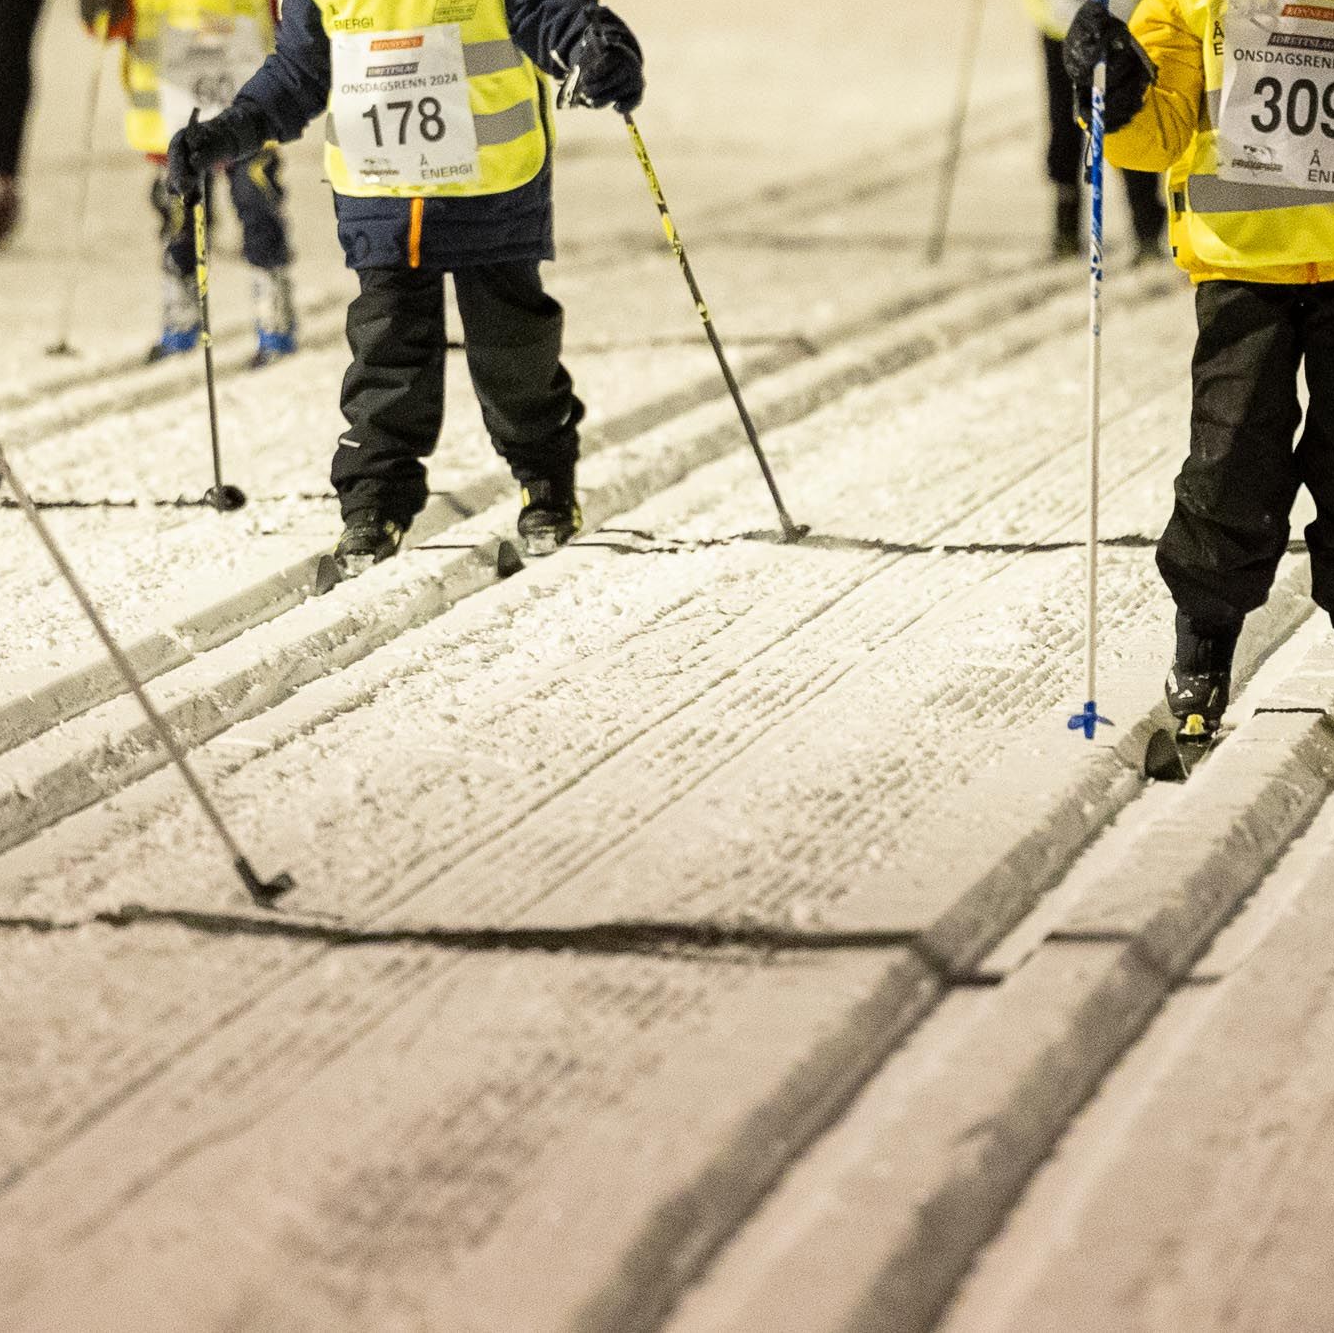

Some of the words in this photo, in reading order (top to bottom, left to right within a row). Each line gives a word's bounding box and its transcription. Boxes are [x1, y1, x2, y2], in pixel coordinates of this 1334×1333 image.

[341, 77, 427, 94] ONSDAGSRENN
[430, 73, 458, 87] 2024
[362, 96, 447, 147] 178
[1310, 149, 1321, 166] Å
[421, 164, 473, 179] ENERGI
